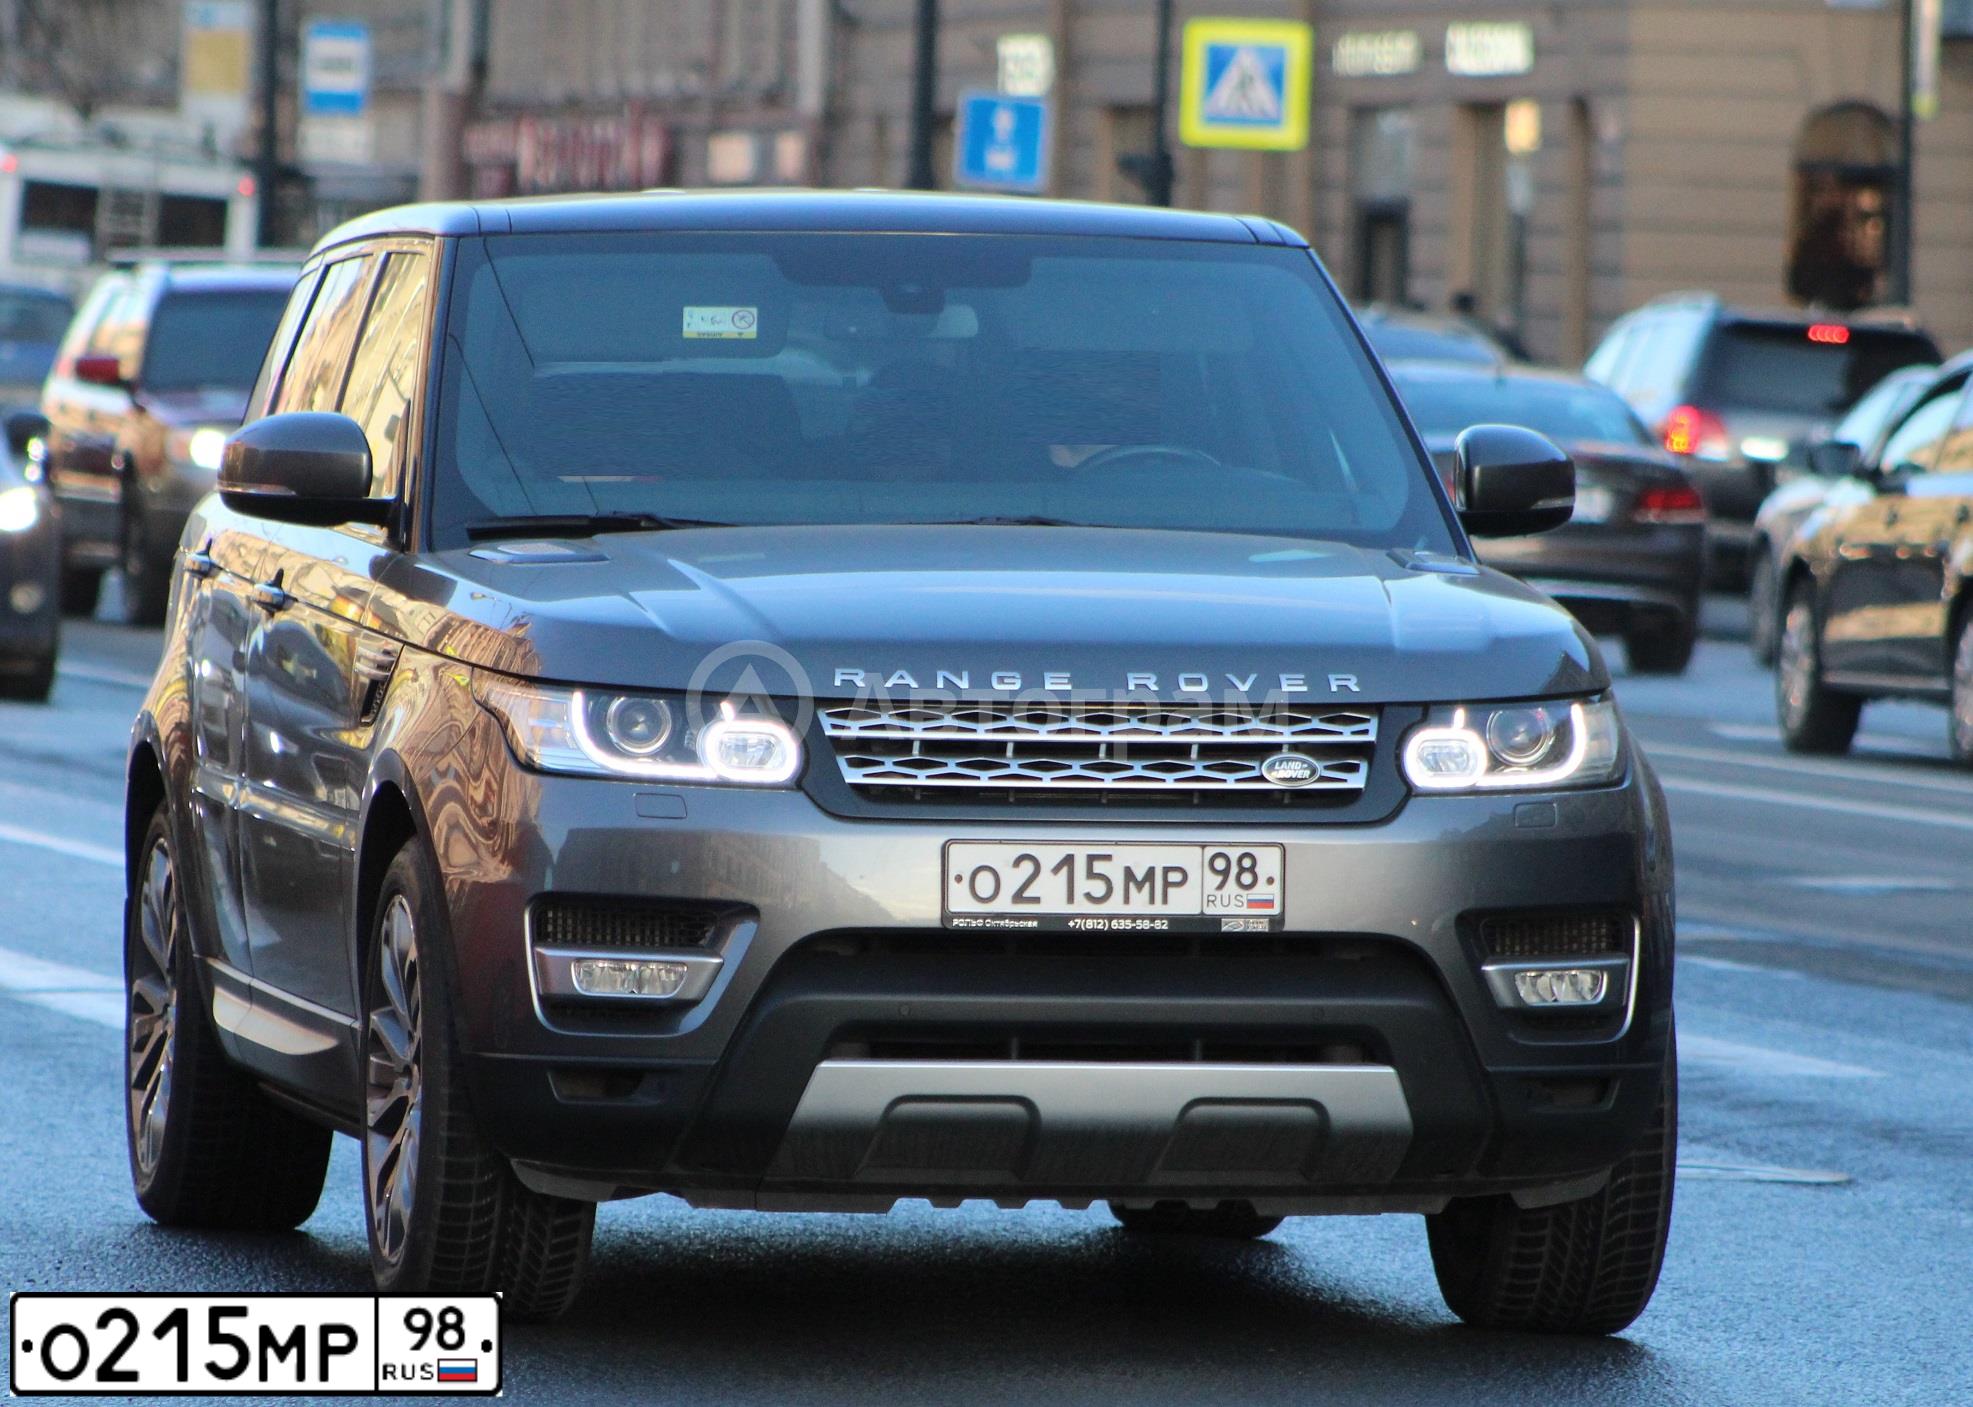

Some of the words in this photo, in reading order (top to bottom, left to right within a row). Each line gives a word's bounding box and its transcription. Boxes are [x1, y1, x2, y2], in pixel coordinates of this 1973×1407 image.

[834, 667, 1073, 692] RANGE
[1127, 671, 1361, 693] ROVER
[1275, 761, 1302, 770] LAND
[1277, 770, 1310, 779] ROVER
[1208, 852, 1258, 891] 98
[1206, 894, 1245, 908] RUS
[1067, 919, 1109, 930] +7(812)
[1111, 919, 1168, 930] 635-58-82
